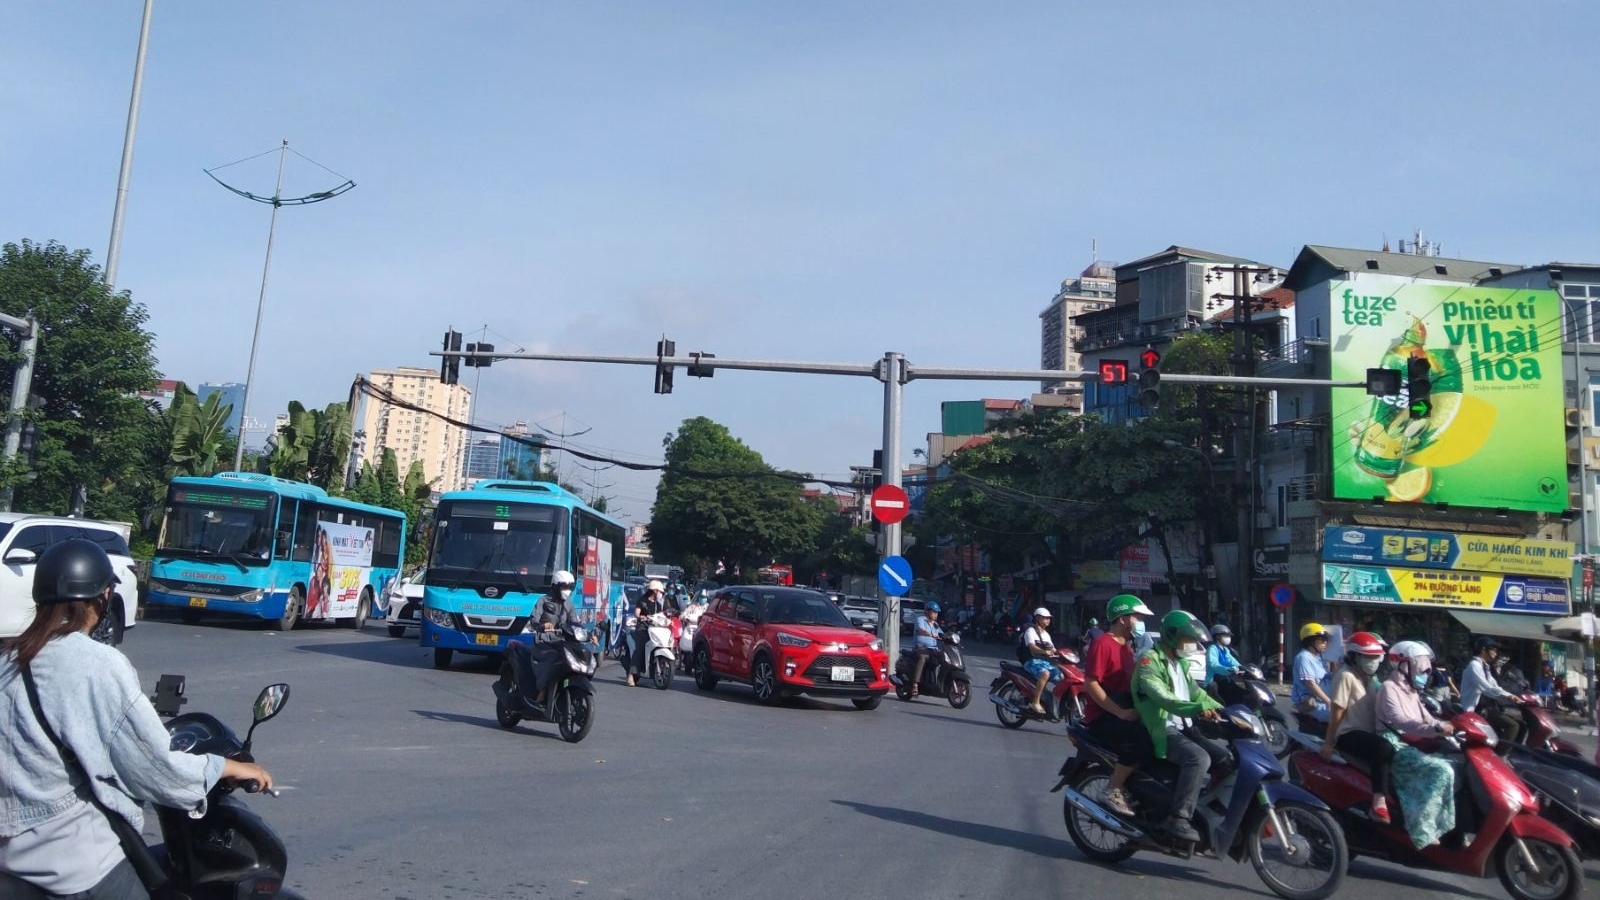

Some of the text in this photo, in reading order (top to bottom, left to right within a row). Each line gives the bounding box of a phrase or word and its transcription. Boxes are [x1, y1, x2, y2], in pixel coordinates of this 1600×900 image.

[1342, 289, 1396, 312] fuze
[1343, 309, 1383, 327] tea
[1481, 323, 1540, 353] hài
[1102, 364, 1126, 383] 57
[1468, 540, 1568, 559] CỬA HÀNG KIM KHÍ
